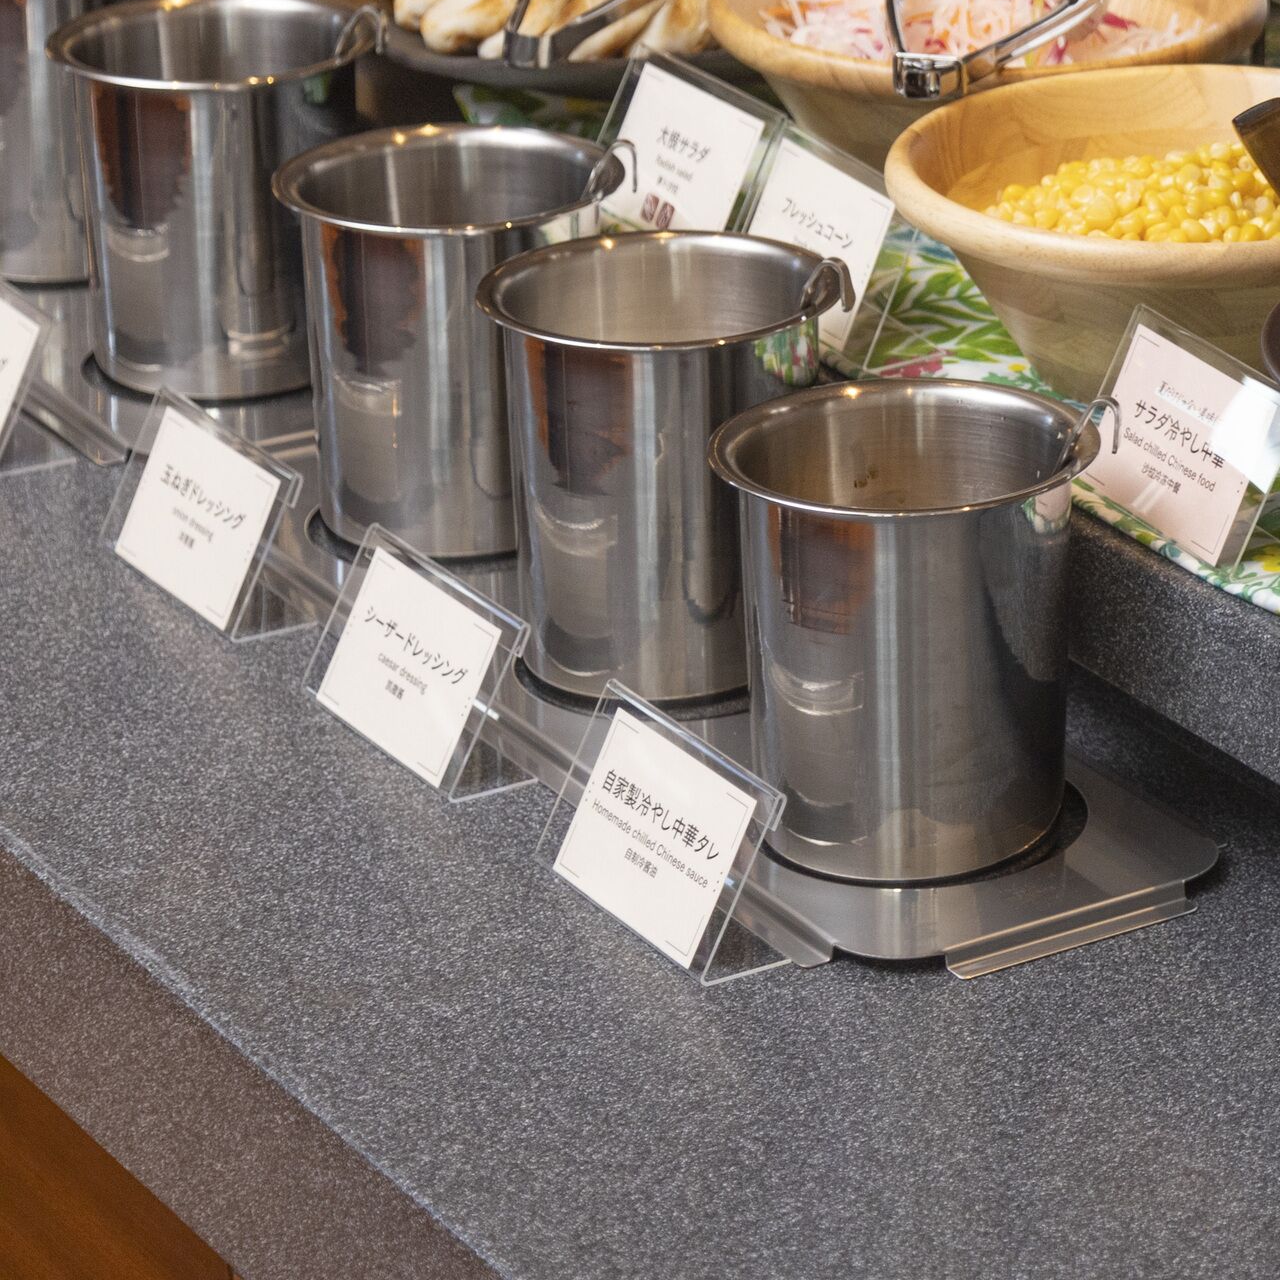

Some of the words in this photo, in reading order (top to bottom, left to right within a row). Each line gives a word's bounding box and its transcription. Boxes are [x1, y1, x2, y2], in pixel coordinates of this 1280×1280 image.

[780, 197, 854, 250] フレッシュコーン
[1124, 427, 1144, 447] Salad
[1167, 454, 1197, 481] Chinese
[1197, 473, 1216, 492] food
[159, 463, 246, 530] 玉ねぎドレッシング
[363, 606, 469, 685] シーザードレッシング
[377, 652, 400, 674] caesar
[399, 665, 429, 696] dressing
[592, 798, 632, 834] Homemade
[632, 829, 656, 851] chilled
[656, 844, 686, 872] Chinese
[686, 867, 708, 888] sauce
[601, 769, 720, 861] 自家製冷やし中華タレ
